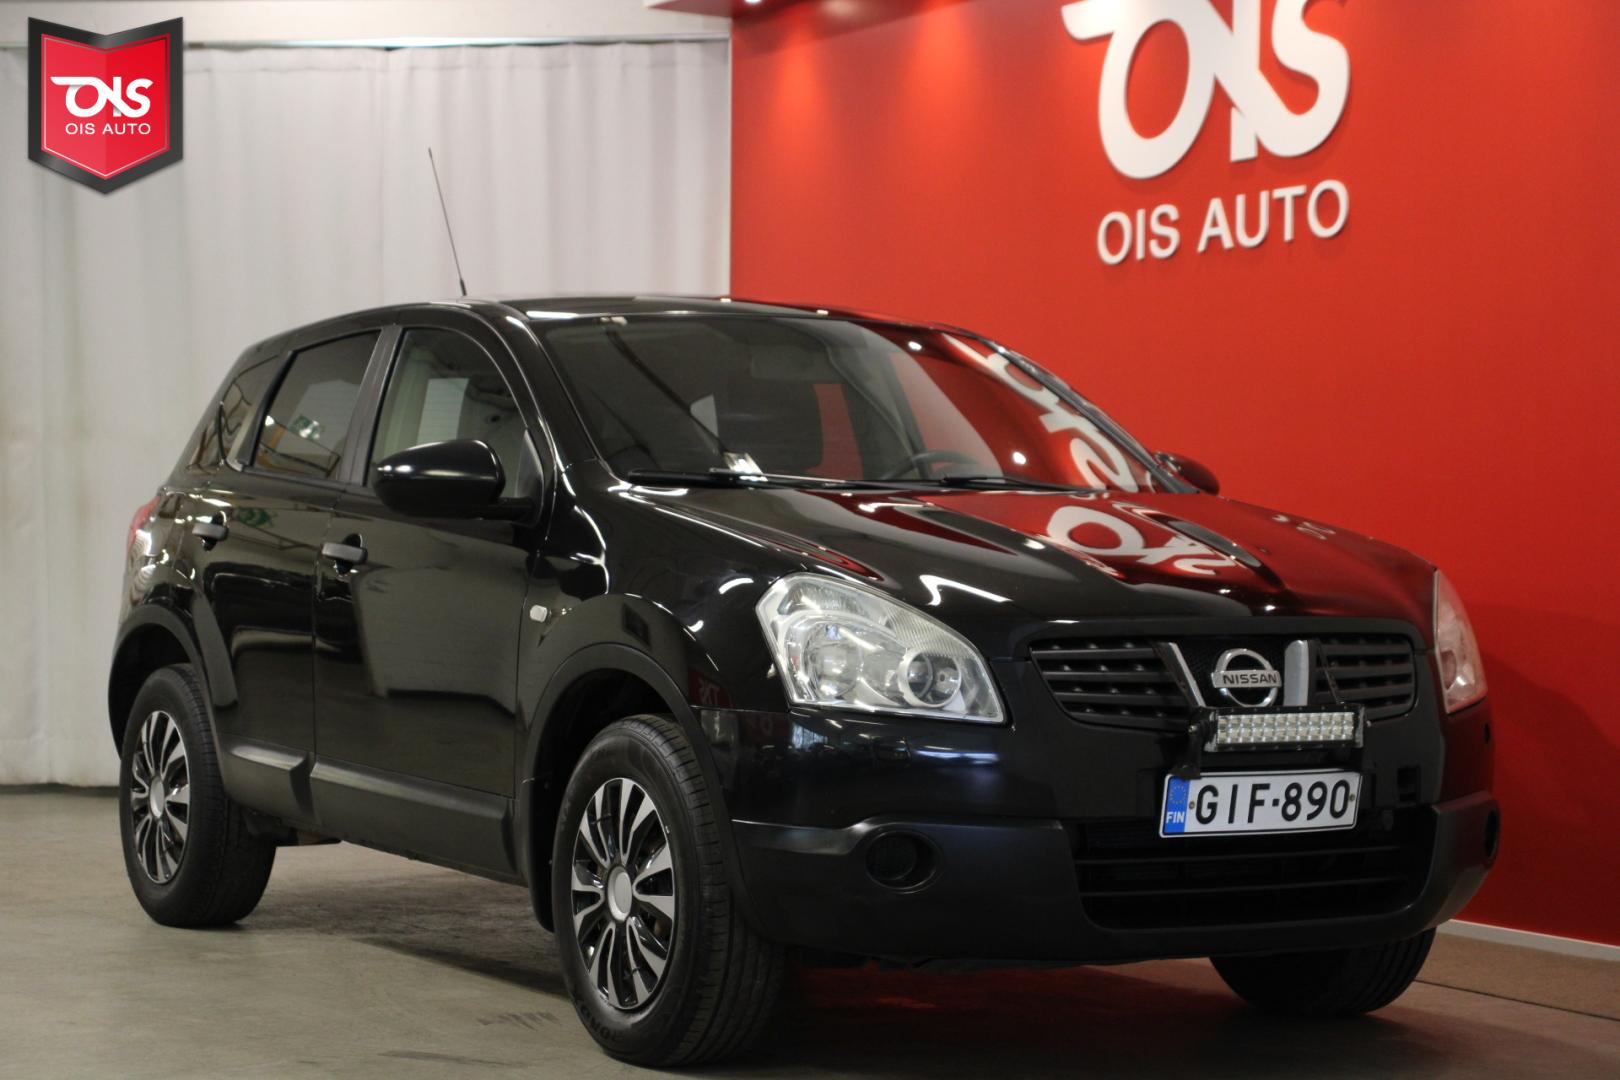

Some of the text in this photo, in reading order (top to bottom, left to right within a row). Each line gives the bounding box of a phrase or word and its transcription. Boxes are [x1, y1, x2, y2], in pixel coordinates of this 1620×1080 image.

[1097, 179, 1349, 265] OIS AUTO
[1222, 673, 1278, 685] NISSAN
[1165, 811, 1185, 824] FIN
